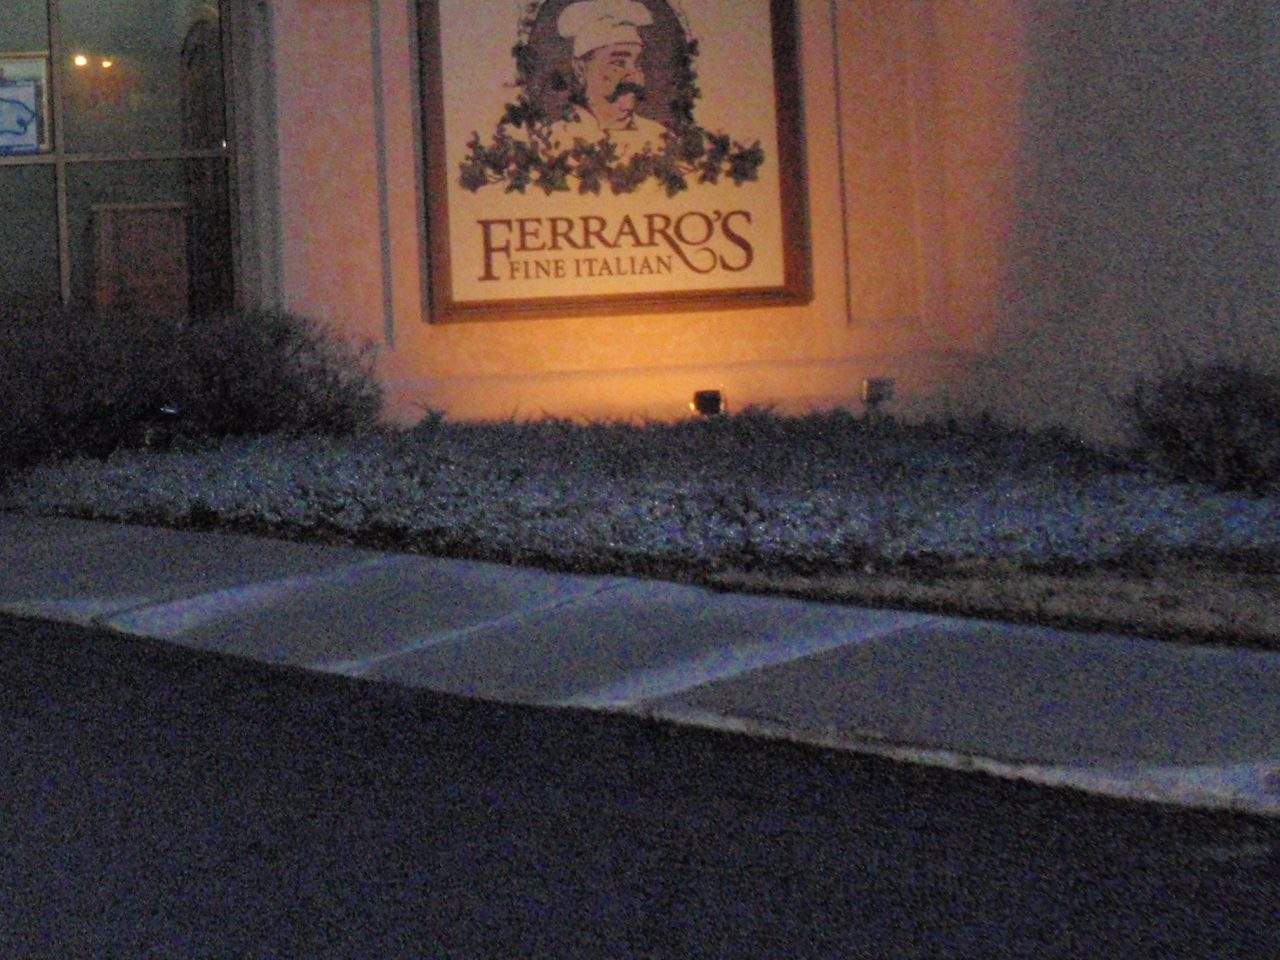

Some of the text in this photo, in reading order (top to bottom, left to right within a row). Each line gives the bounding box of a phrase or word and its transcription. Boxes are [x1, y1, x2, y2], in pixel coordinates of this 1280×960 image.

[476, 210, 754, 281] FERRARO'S
[509, 254, 673, 280] FINE ITALIAN
